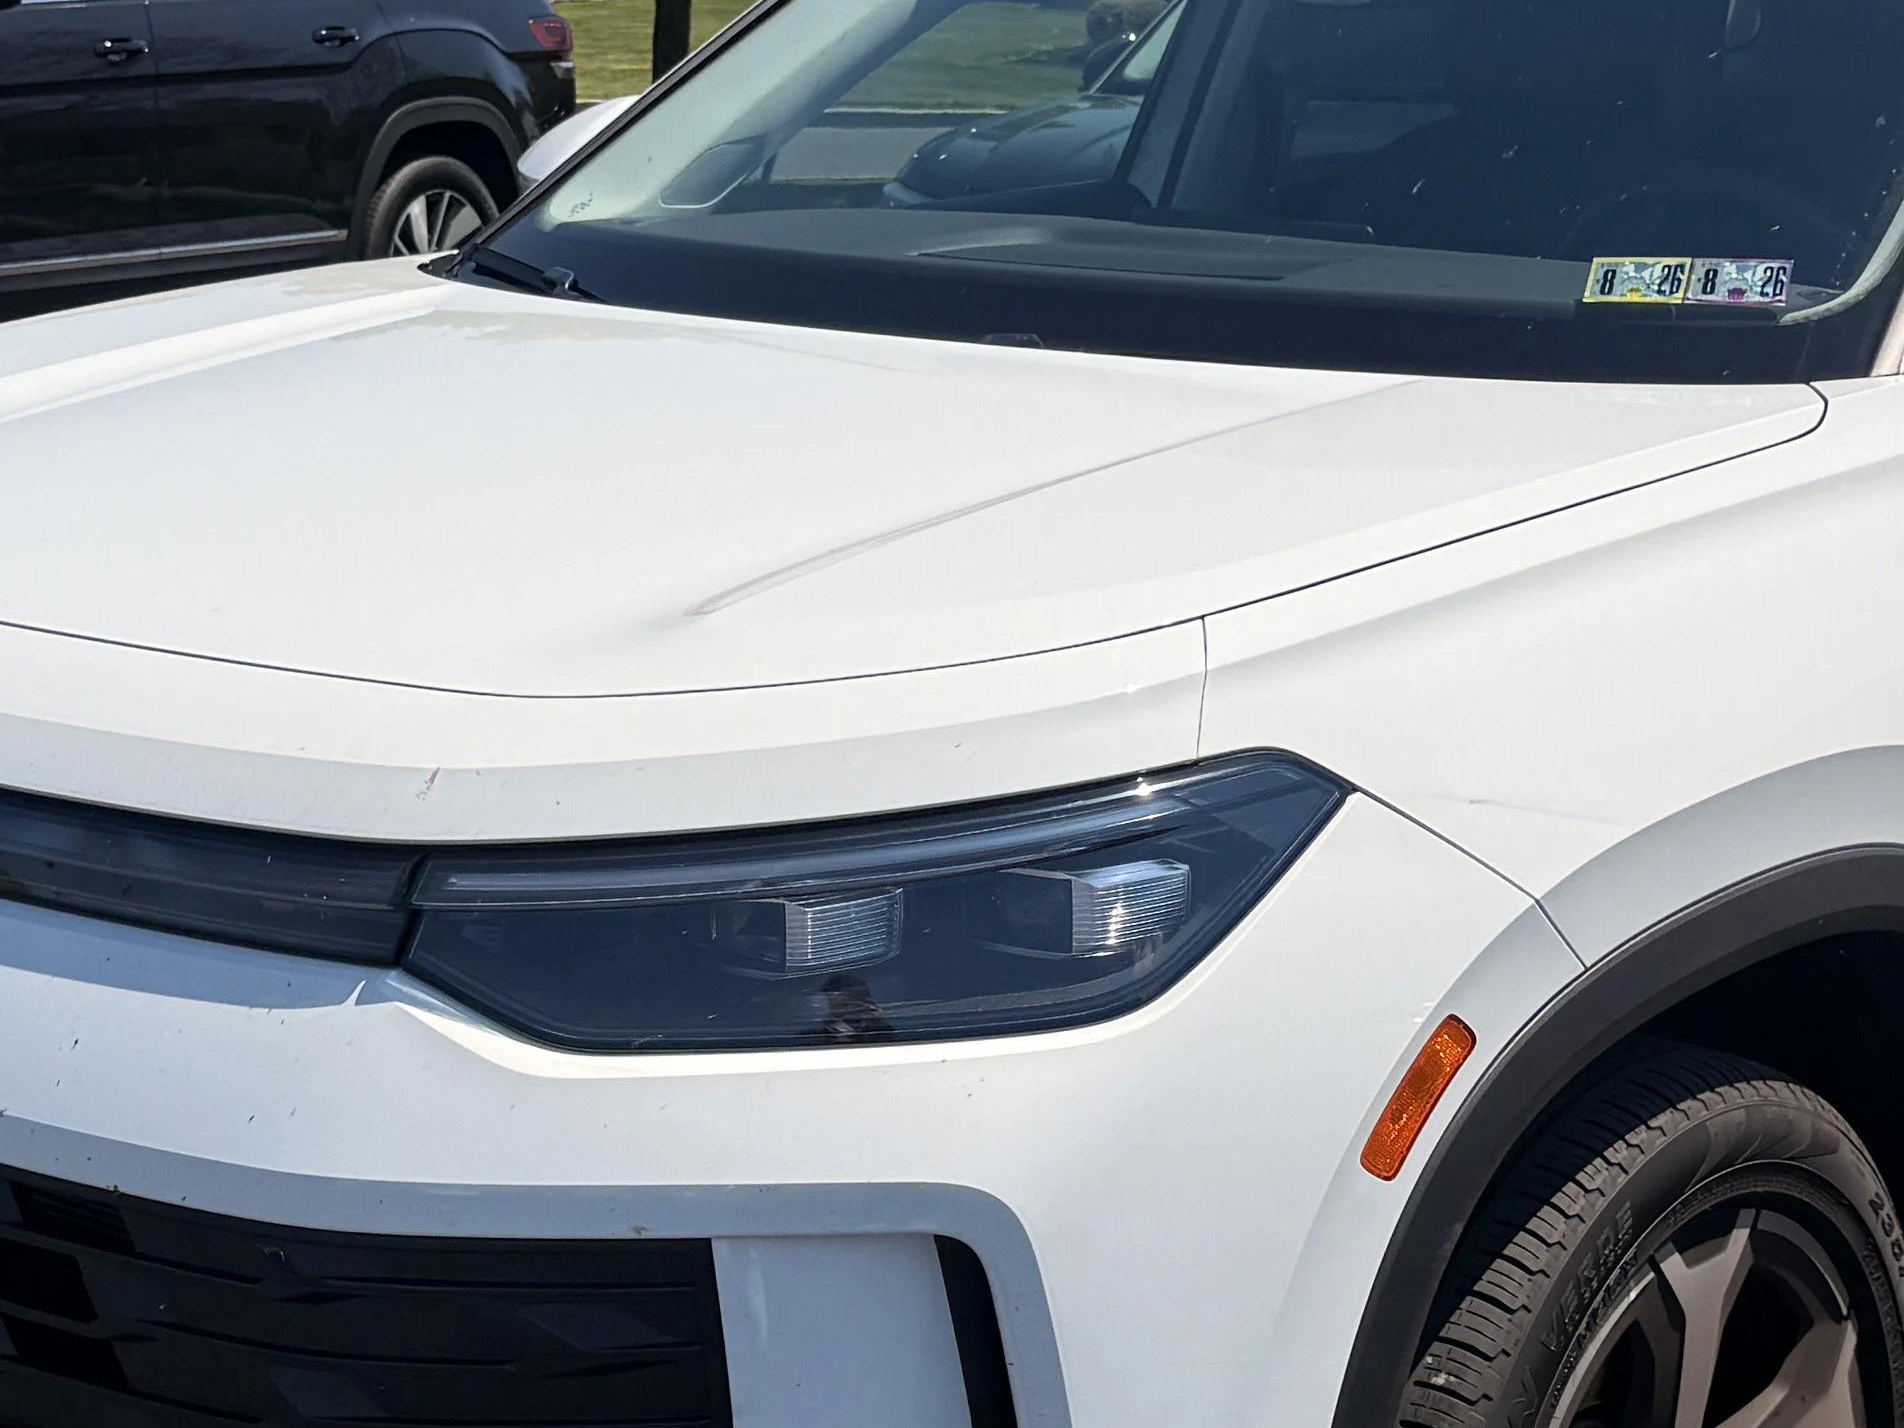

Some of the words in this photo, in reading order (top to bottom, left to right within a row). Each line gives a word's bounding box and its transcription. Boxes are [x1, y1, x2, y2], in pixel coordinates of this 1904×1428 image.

[1599, 268, 1617, 296] 8
[1656, 264, 1685, 296] 26
[1700, 268, 1719, 296] 8
[1759, 265, 1787, 297] 26
[1542, 1200, 1633, 1352] VERDE
